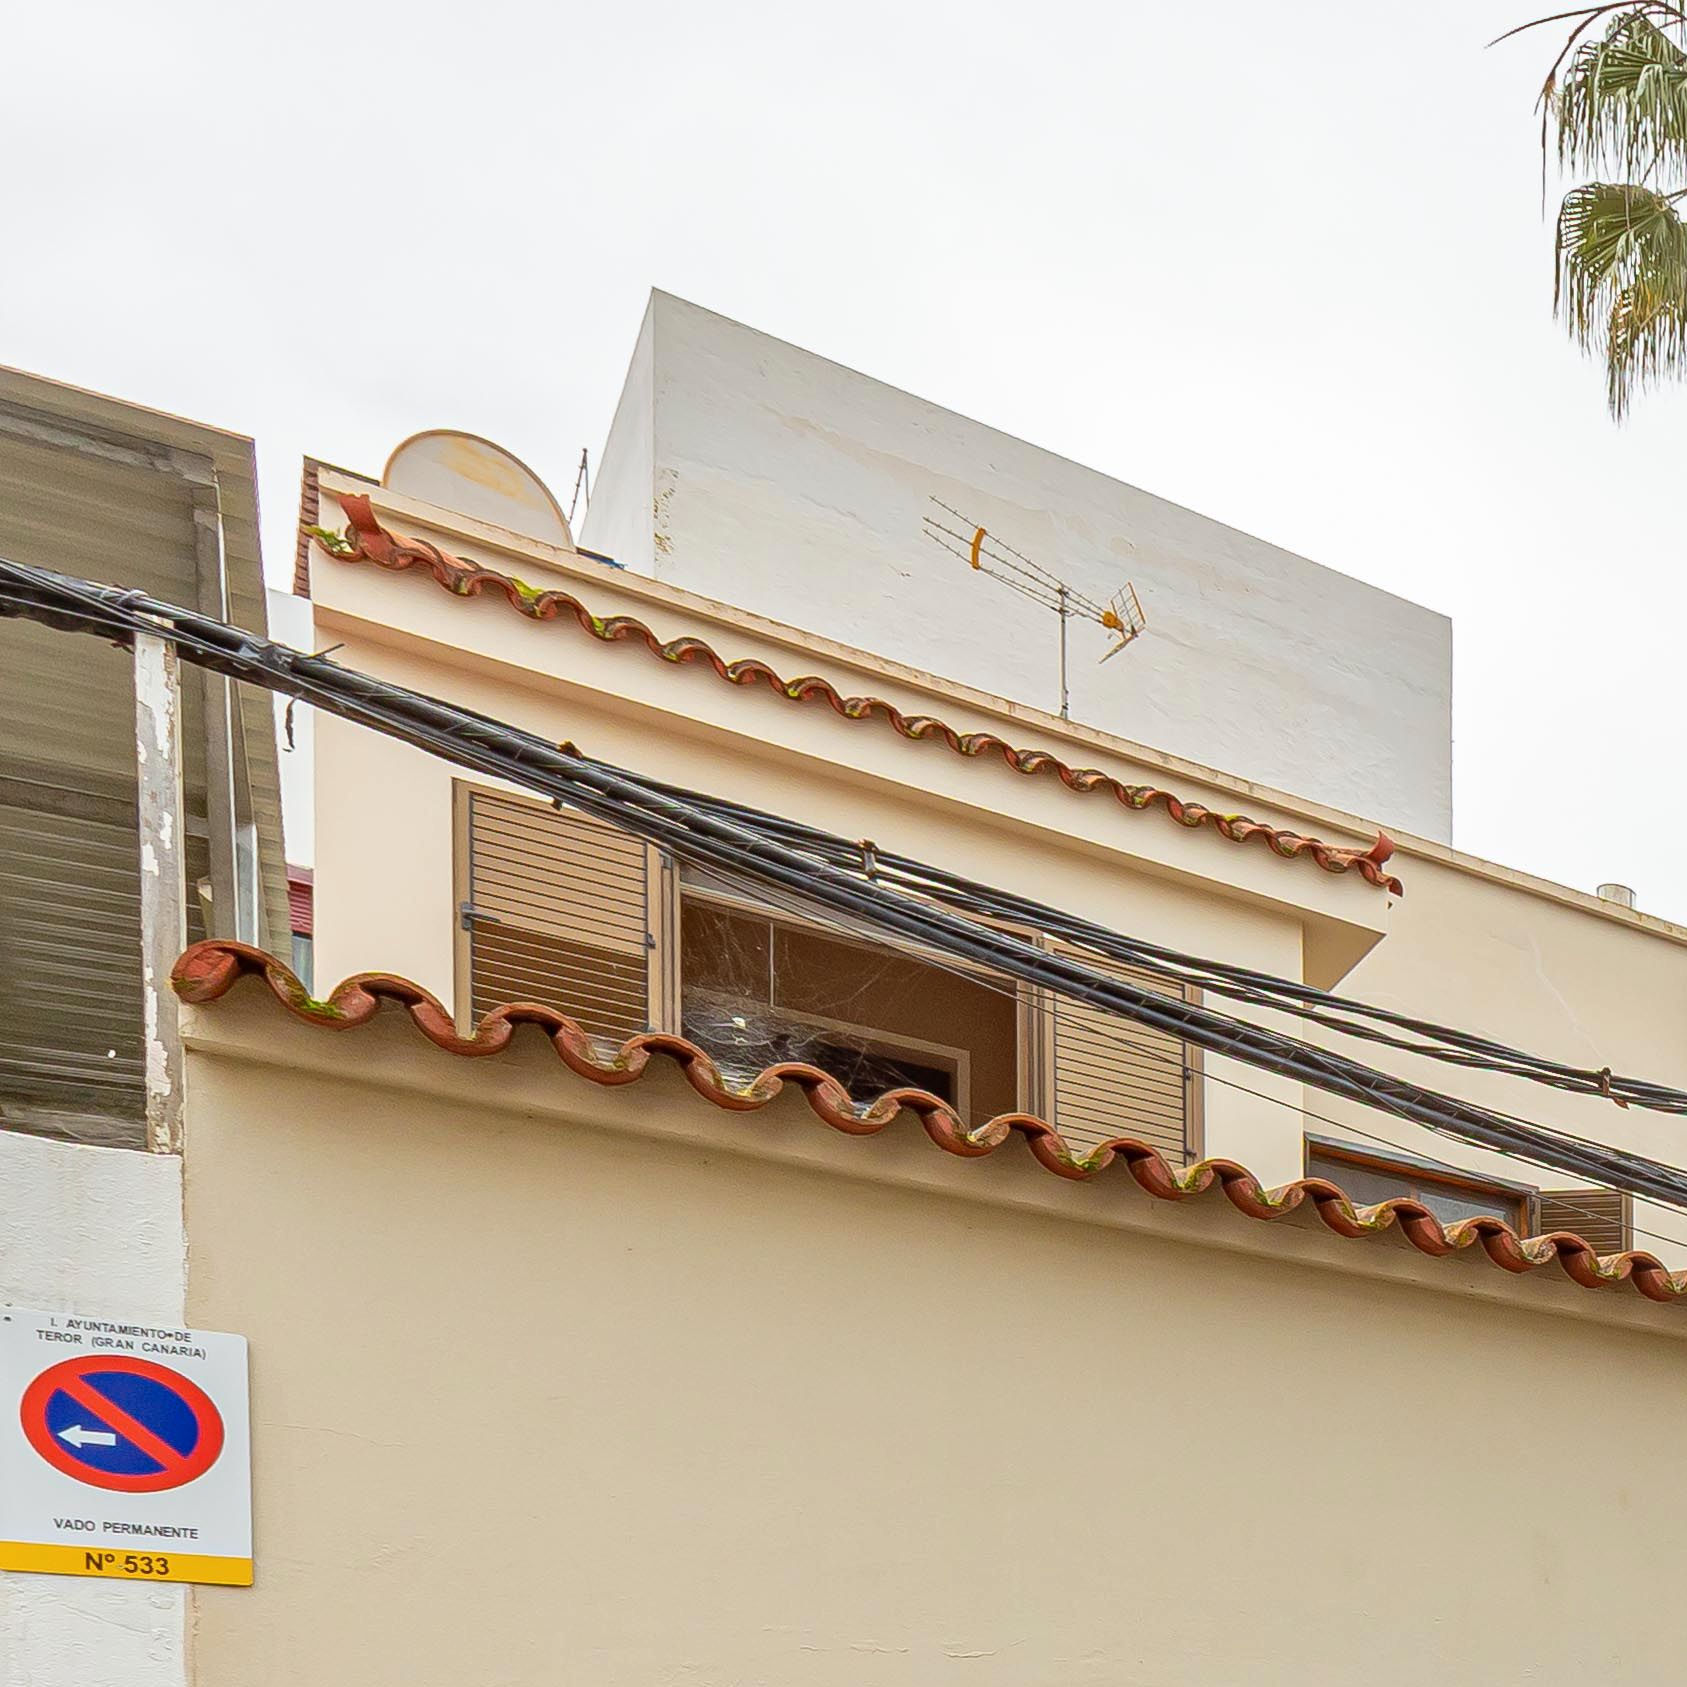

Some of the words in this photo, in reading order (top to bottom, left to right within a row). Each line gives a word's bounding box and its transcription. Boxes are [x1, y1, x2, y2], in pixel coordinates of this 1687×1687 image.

[66, 1319, 167, 1340] AYUNTAMIENTO
[174, 1331, 192, 1343] DE
[36, 1329, 83, 1344] TEROR
[91, 1337, 134, 1350] (GRAN
[142, 1342, 207, 1360] CANARIA)
[53, 1518, 96, 1532] VADO
[103, 1521, 199, 1539] PERMANENTE
[124, 1555, 170, 1576] 533
